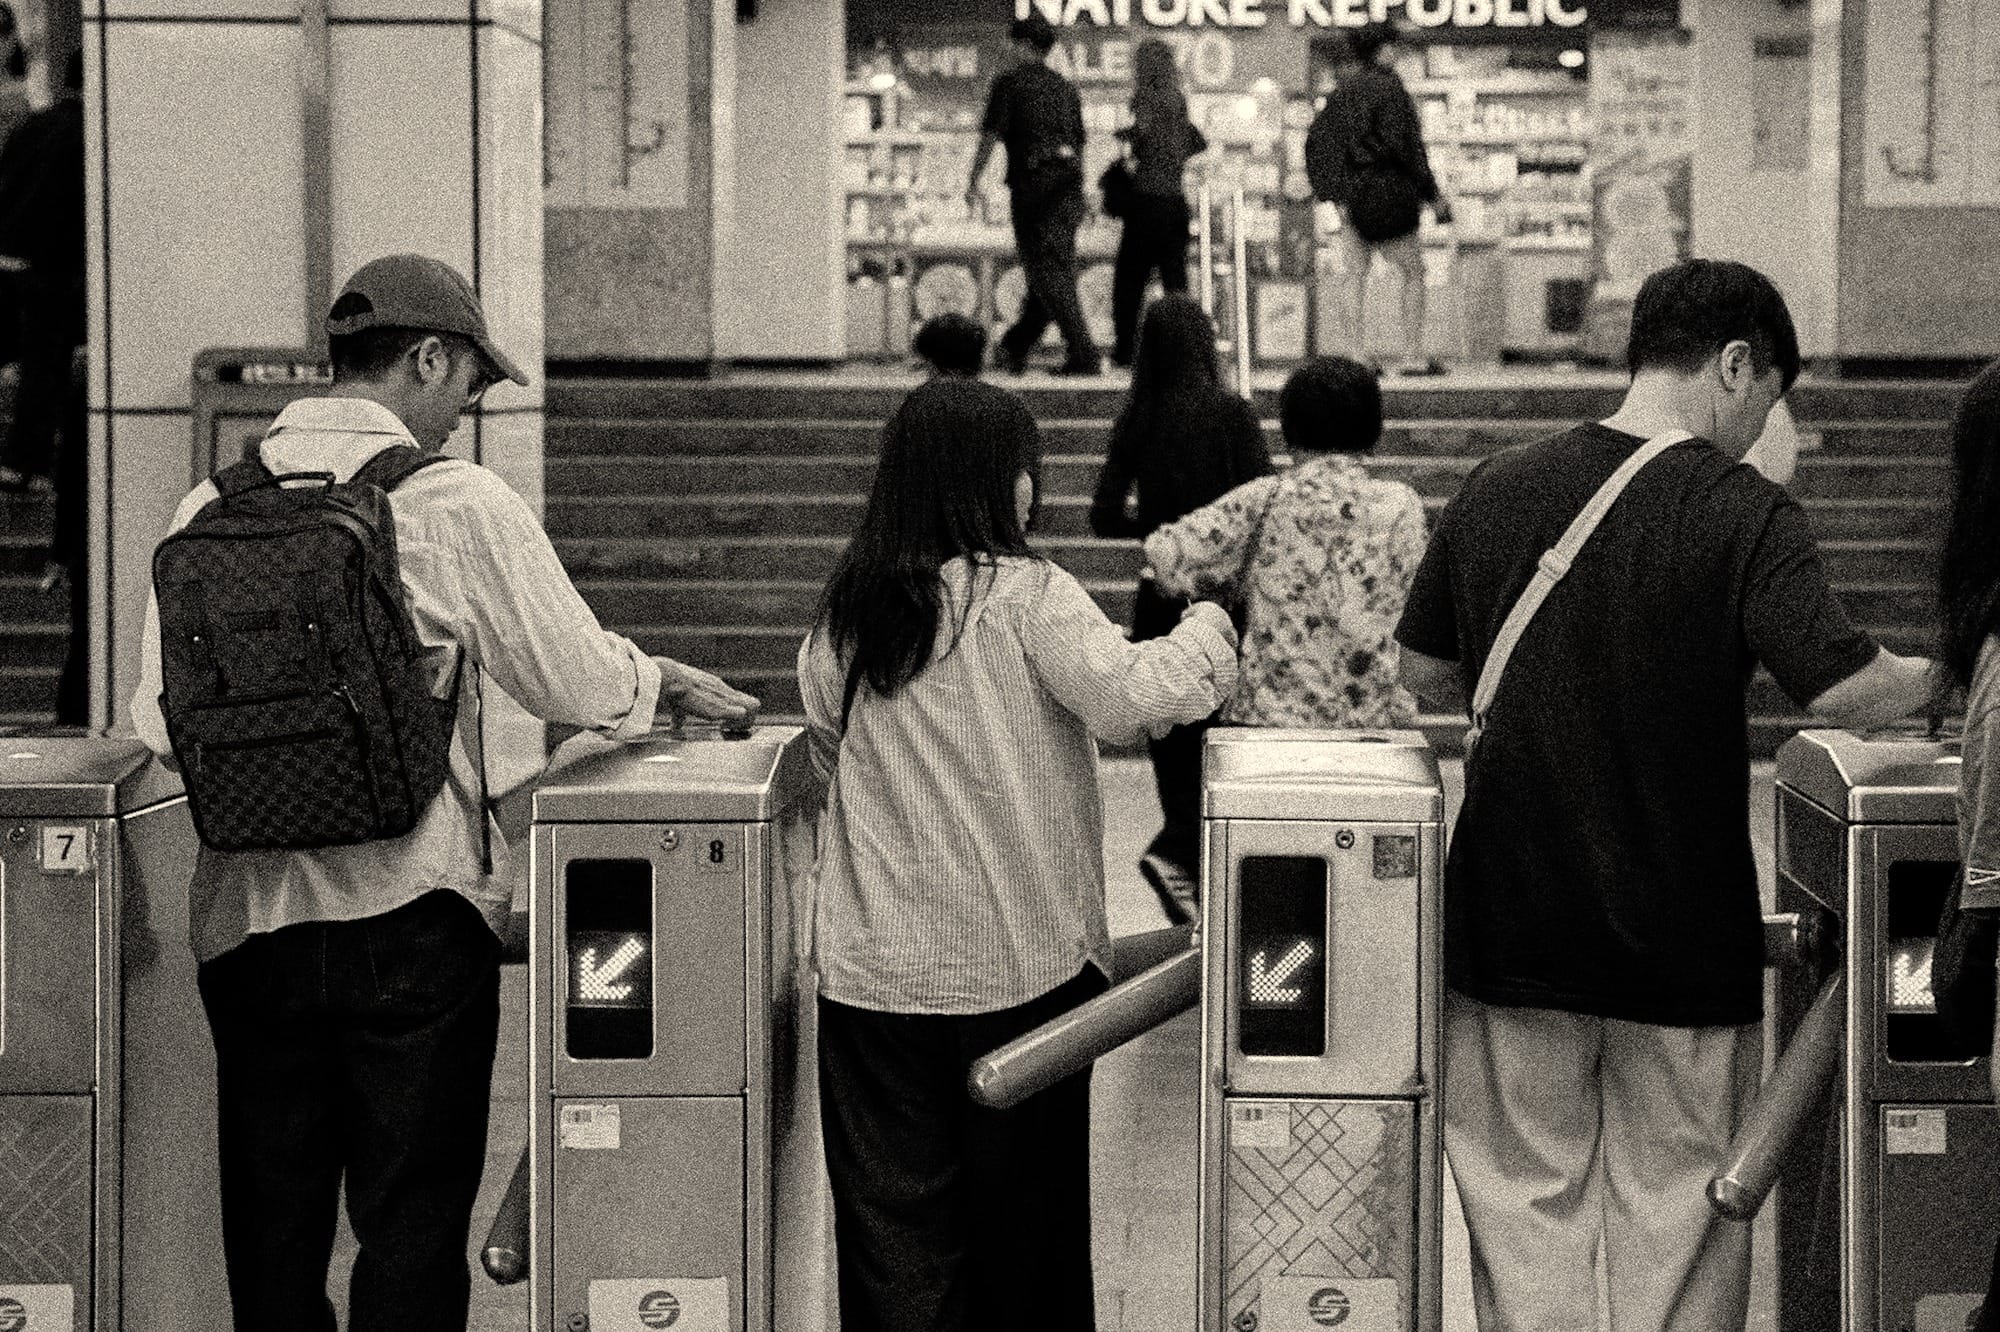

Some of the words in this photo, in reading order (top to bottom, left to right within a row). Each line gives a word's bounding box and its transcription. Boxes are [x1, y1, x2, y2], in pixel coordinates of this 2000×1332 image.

[1043, 41, 1133, 81] ALE
[57, 834, 76, 860] 7
[709, 839, 725, 864] 8
